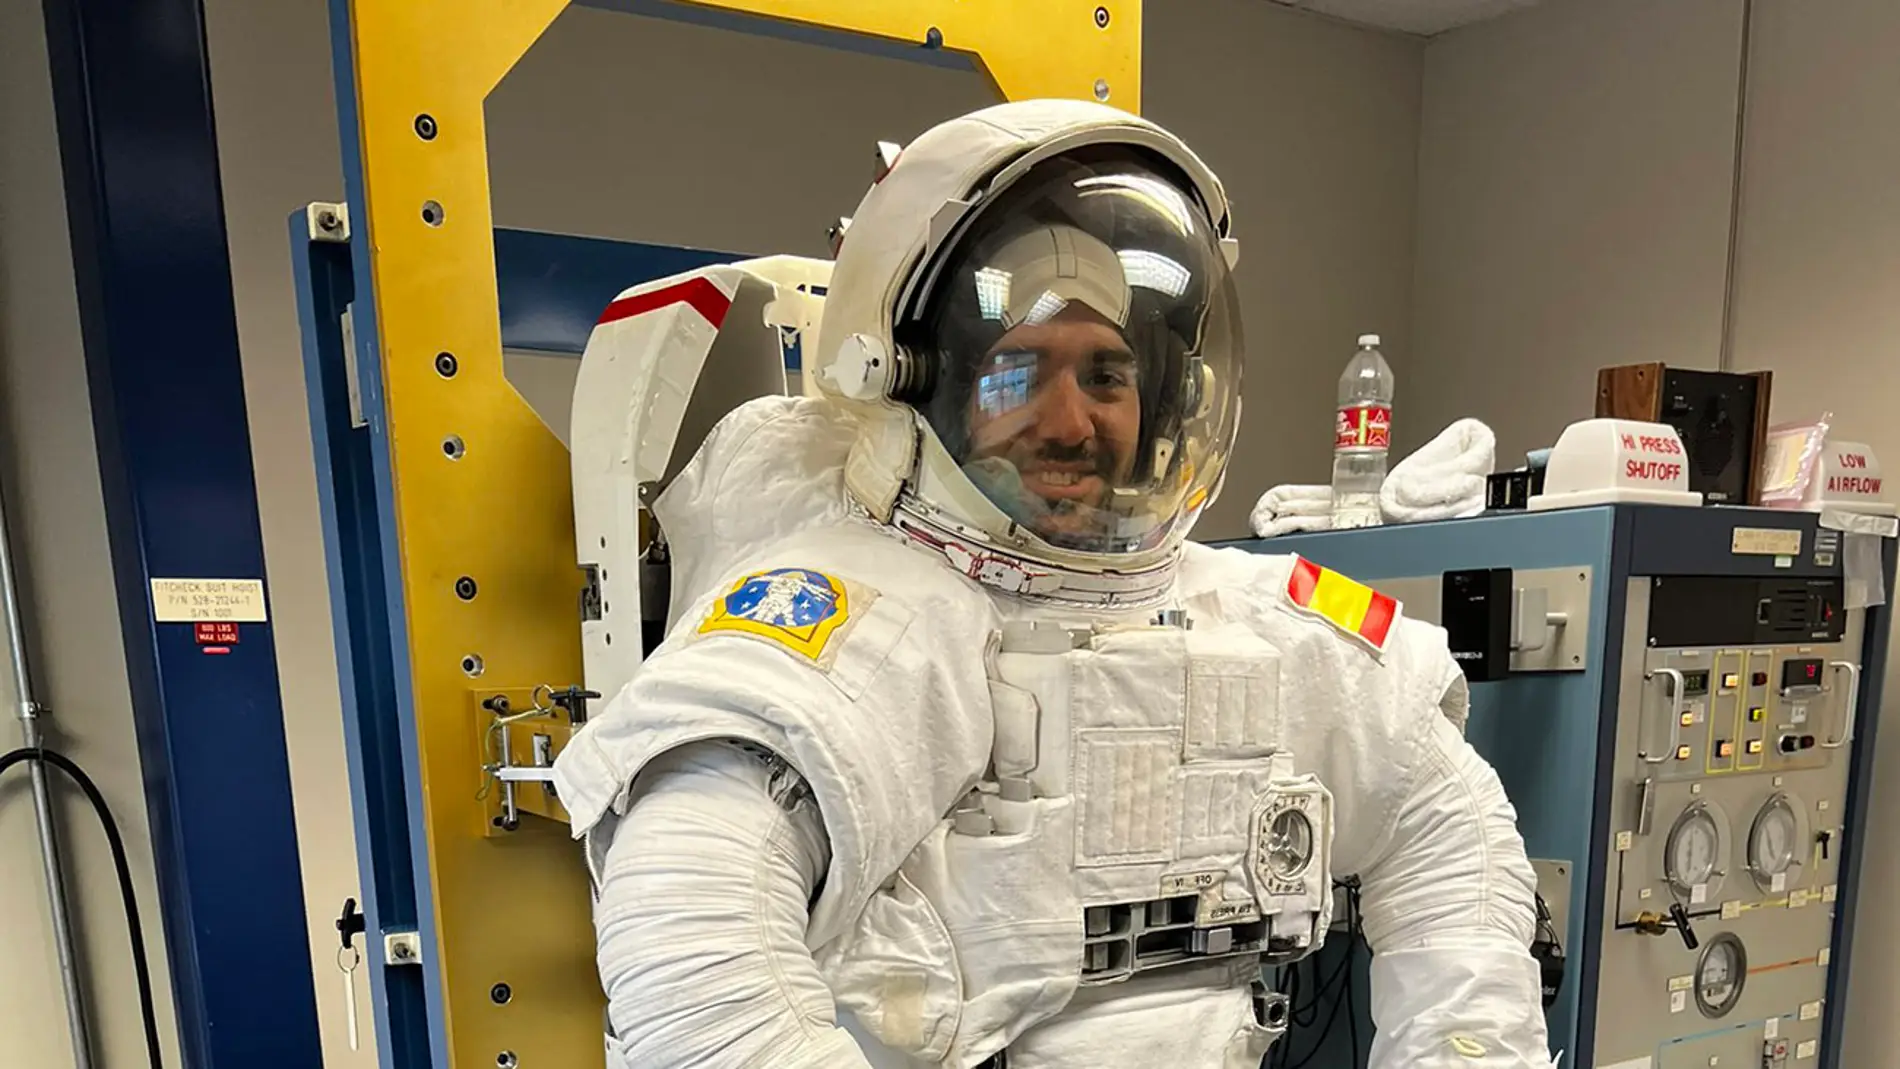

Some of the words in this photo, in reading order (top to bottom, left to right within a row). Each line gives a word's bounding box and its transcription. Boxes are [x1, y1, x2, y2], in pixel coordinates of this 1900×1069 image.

[1621, 433, 1636, 449] HI
[1639, 435, 1681, 454] PRESS
[1626, 459, 1681, 480] SHUTOFF
[1838, 453, 1866, 468] LOW
[1827, 476, 1882, 494] AIRFLOW
